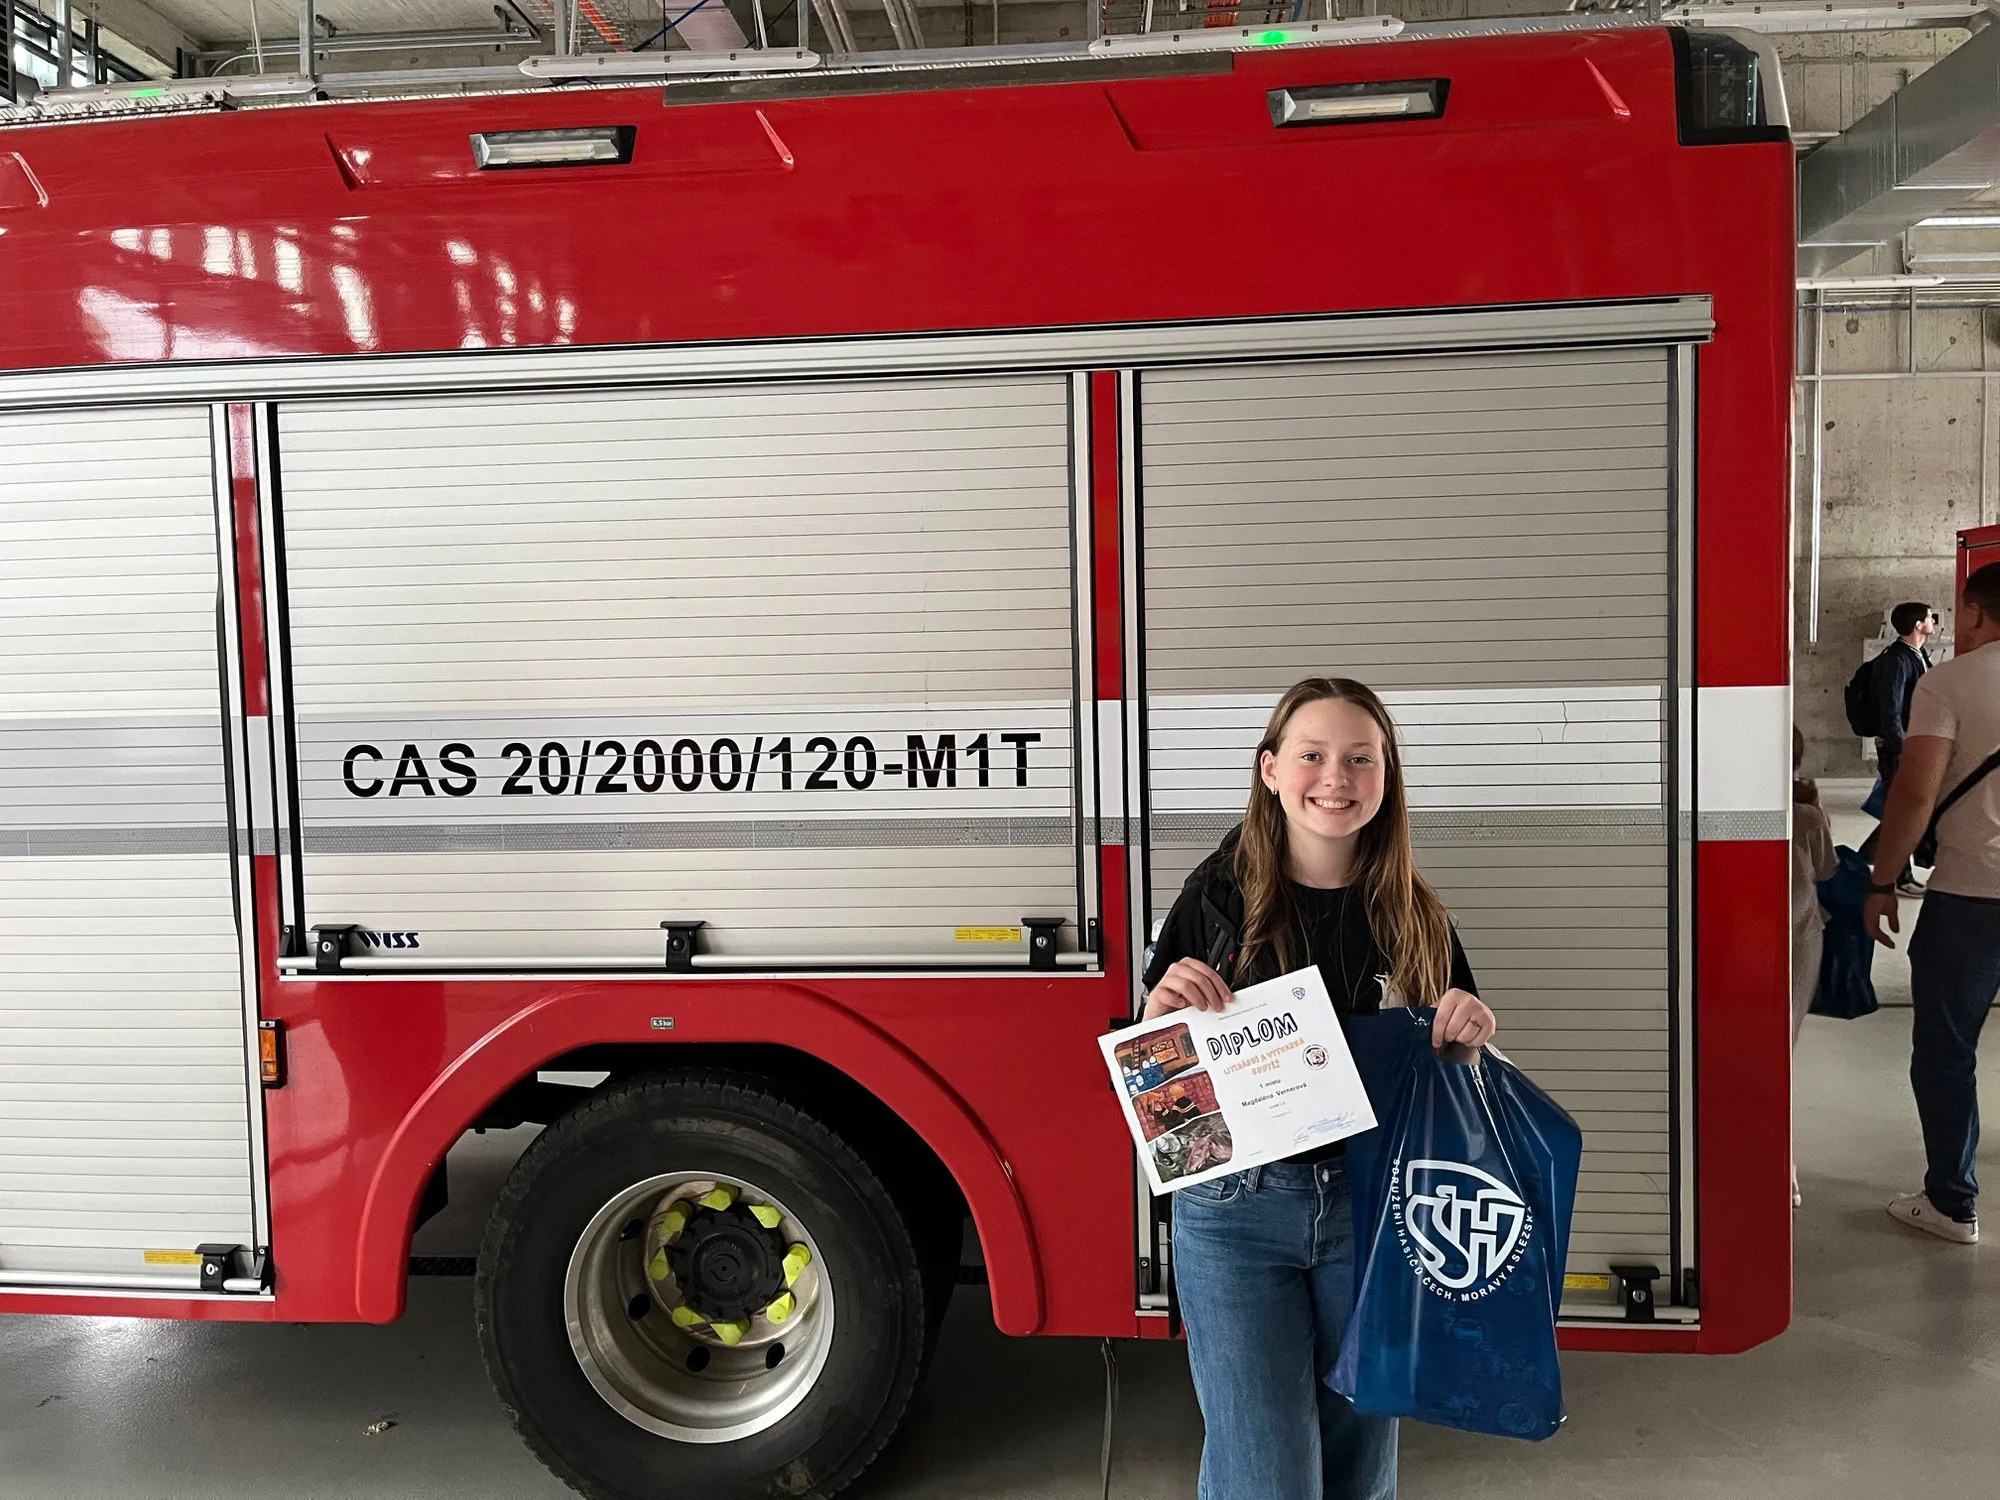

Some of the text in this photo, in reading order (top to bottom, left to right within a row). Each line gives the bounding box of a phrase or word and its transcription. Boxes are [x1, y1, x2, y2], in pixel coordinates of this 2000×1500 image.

[343, 732, 1042, 798] CAS 20/2000/120-M1T
[356, 930, 420, 949] WISS
[1206, 1012, 1298, 1061] DIPLOM
[1260, 1054, 1267, 1062] A
[1241, 1093, 1274, 1107] Magdalena
[1461, 1273, 1508, 1302] MORAVY
[1506, 1263, 1516, 1274] A
[1511, 1206, 1534, 1262] SLEZSKA
